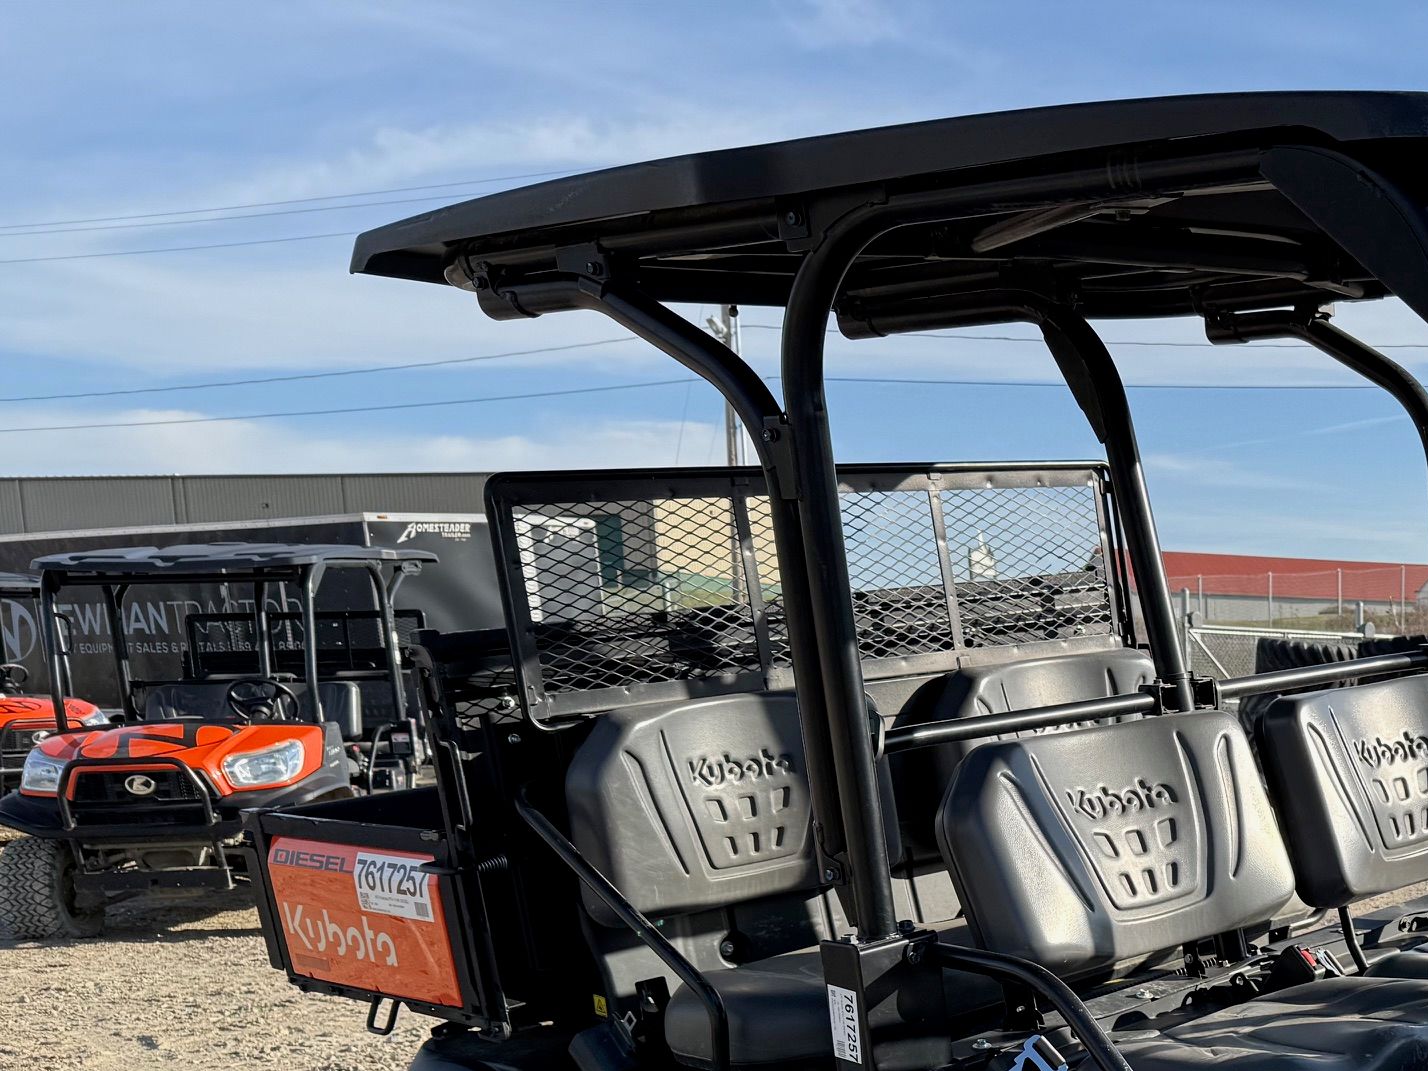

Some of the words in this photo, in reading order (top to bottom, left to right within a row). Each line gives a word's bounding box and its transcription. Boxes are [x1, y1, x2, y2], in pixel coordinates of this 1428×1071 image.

[136, 642, 169, 653] SALES
[688, 748, 797, 786] Kubota
[1066, 777, 1178, 820] Kubota
[273, 848, 354, 873] DIESEL
[357, 858, 428, 898] 7617257
[283, 902, 398, 967] Kubota
[844, 995, 859, 1063] 7617257
